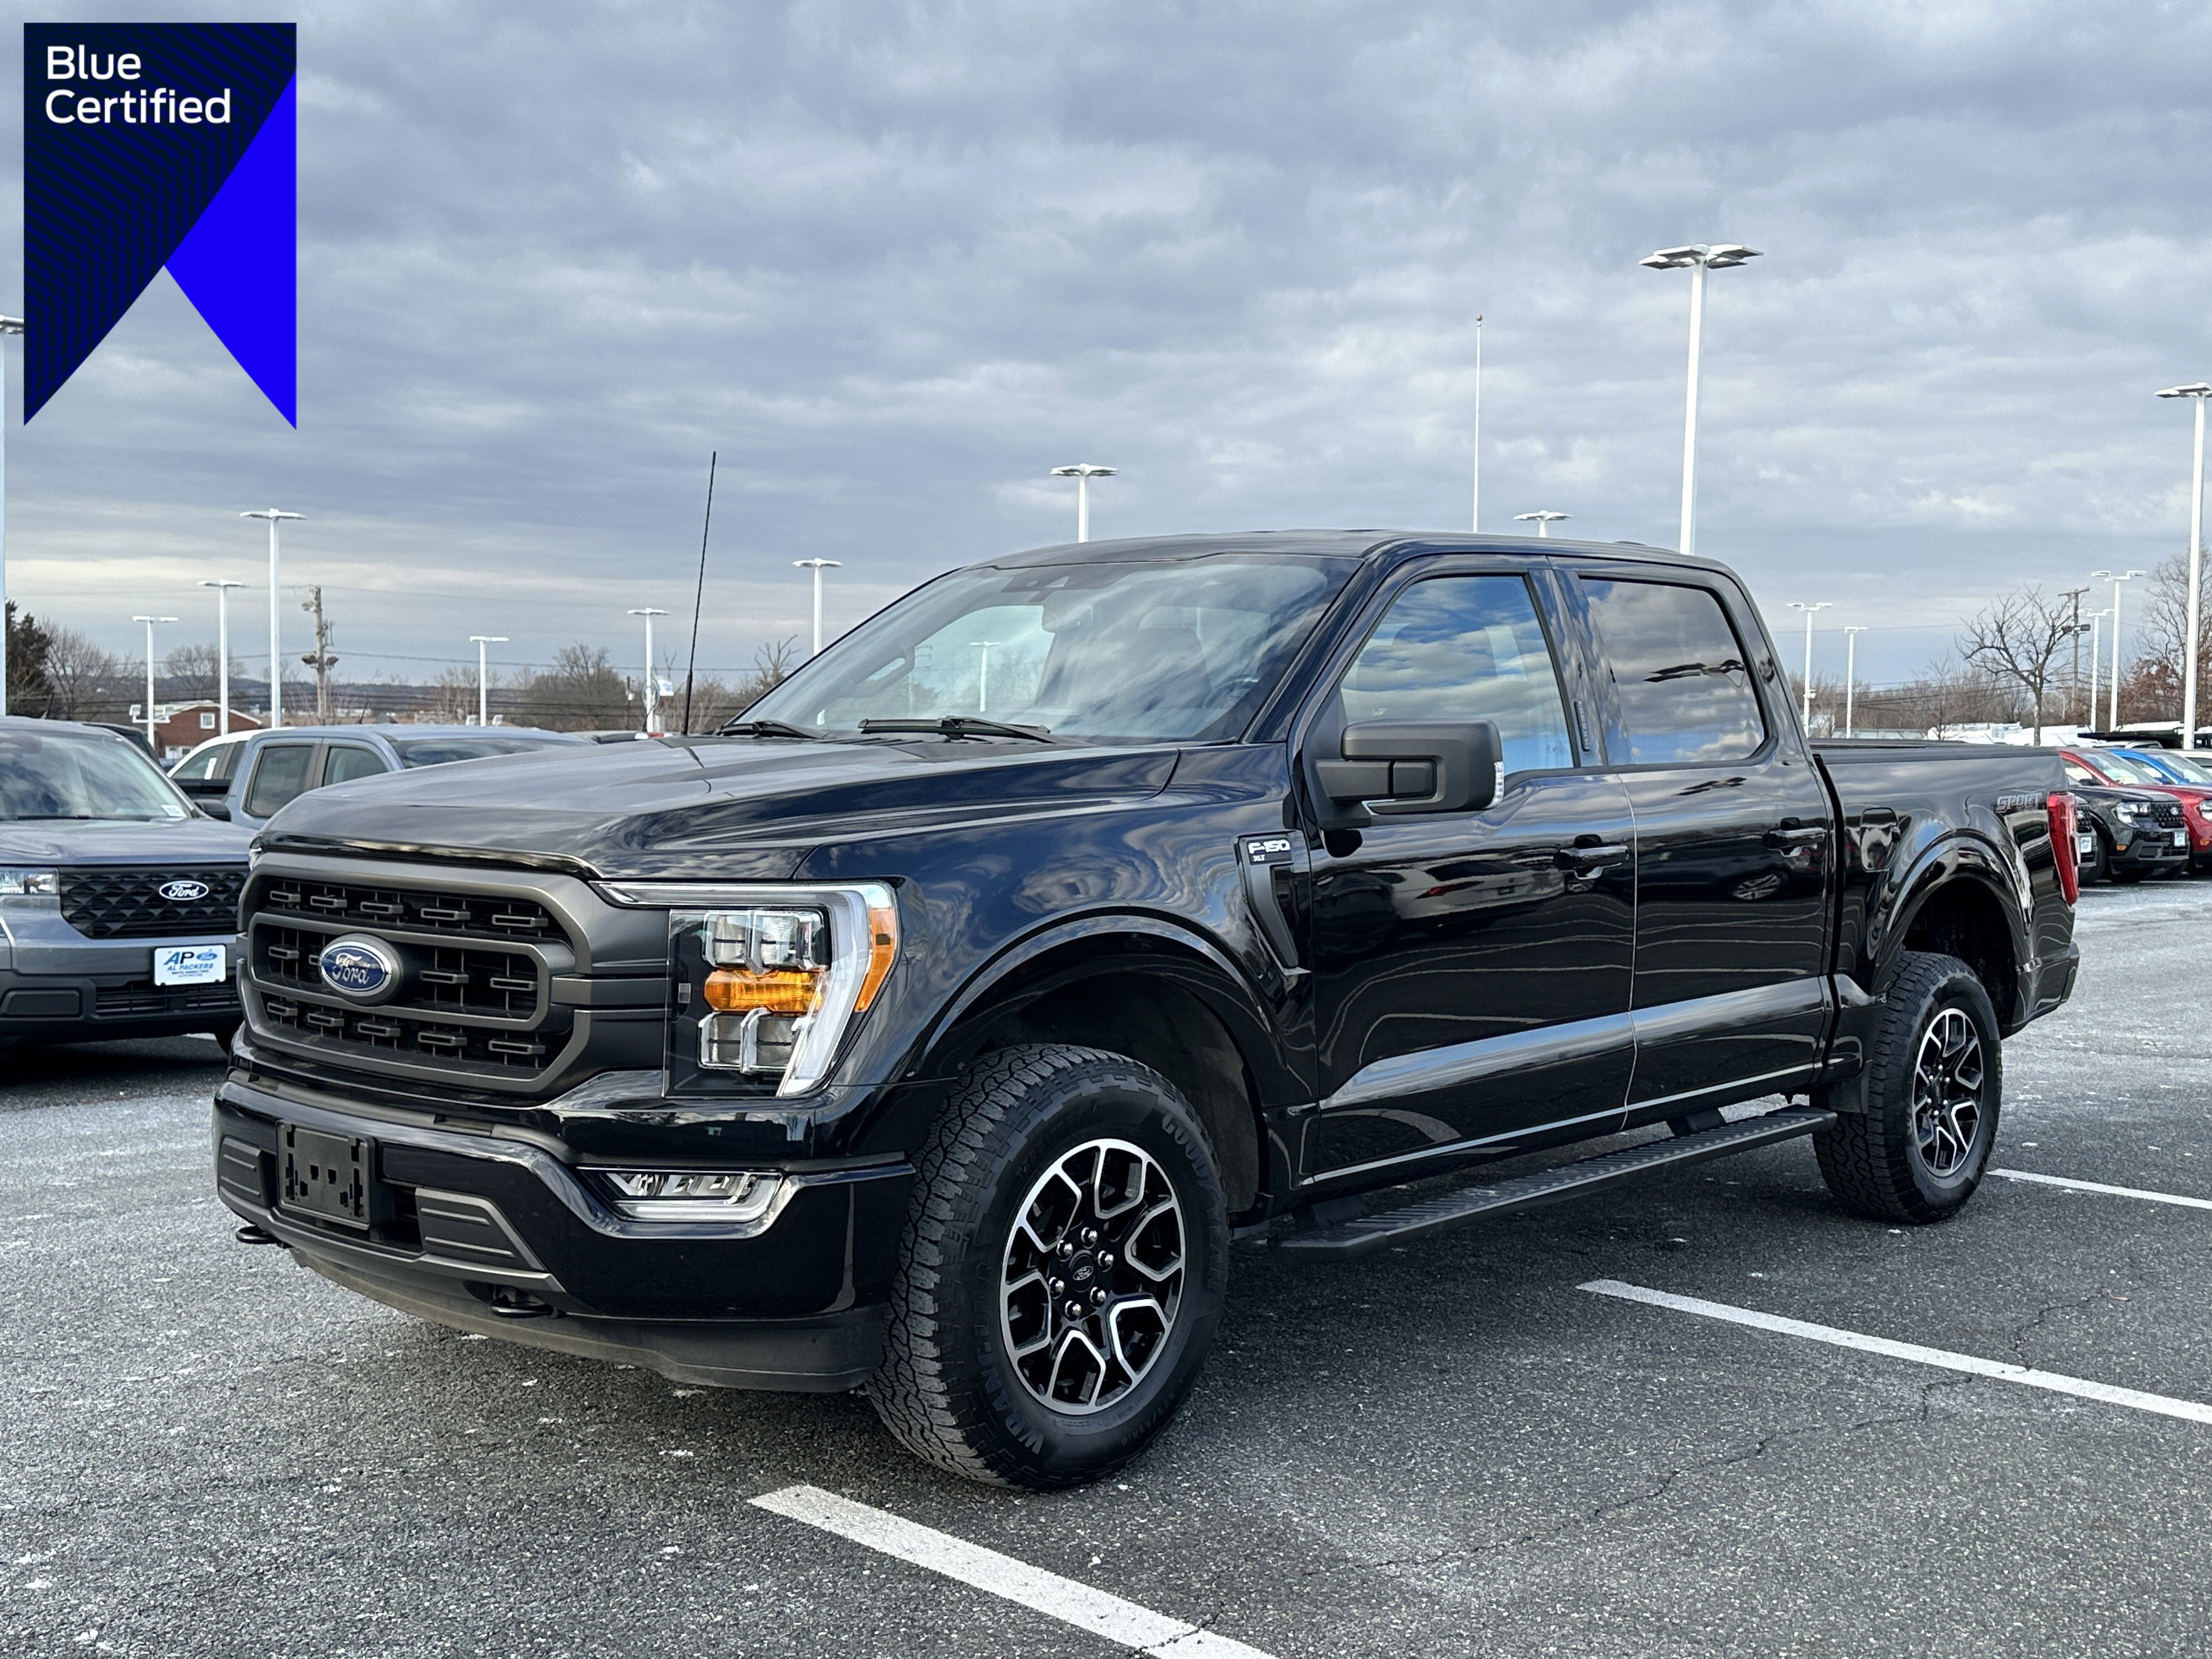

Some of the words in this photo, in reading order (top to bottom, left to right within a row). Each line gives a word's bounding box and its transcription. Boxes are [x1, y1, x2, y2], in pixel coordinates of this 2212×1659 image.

[1995, 792, 2042, 813] SPORT
[1248, 839, 1290, 854] F-150
[168, 883, 199, 897] Ford
[163, 951, 195, 966] AP
[332, 952, 370, 984] Ford
[1161, 1113, 1223, 1294] GOODYEAR
